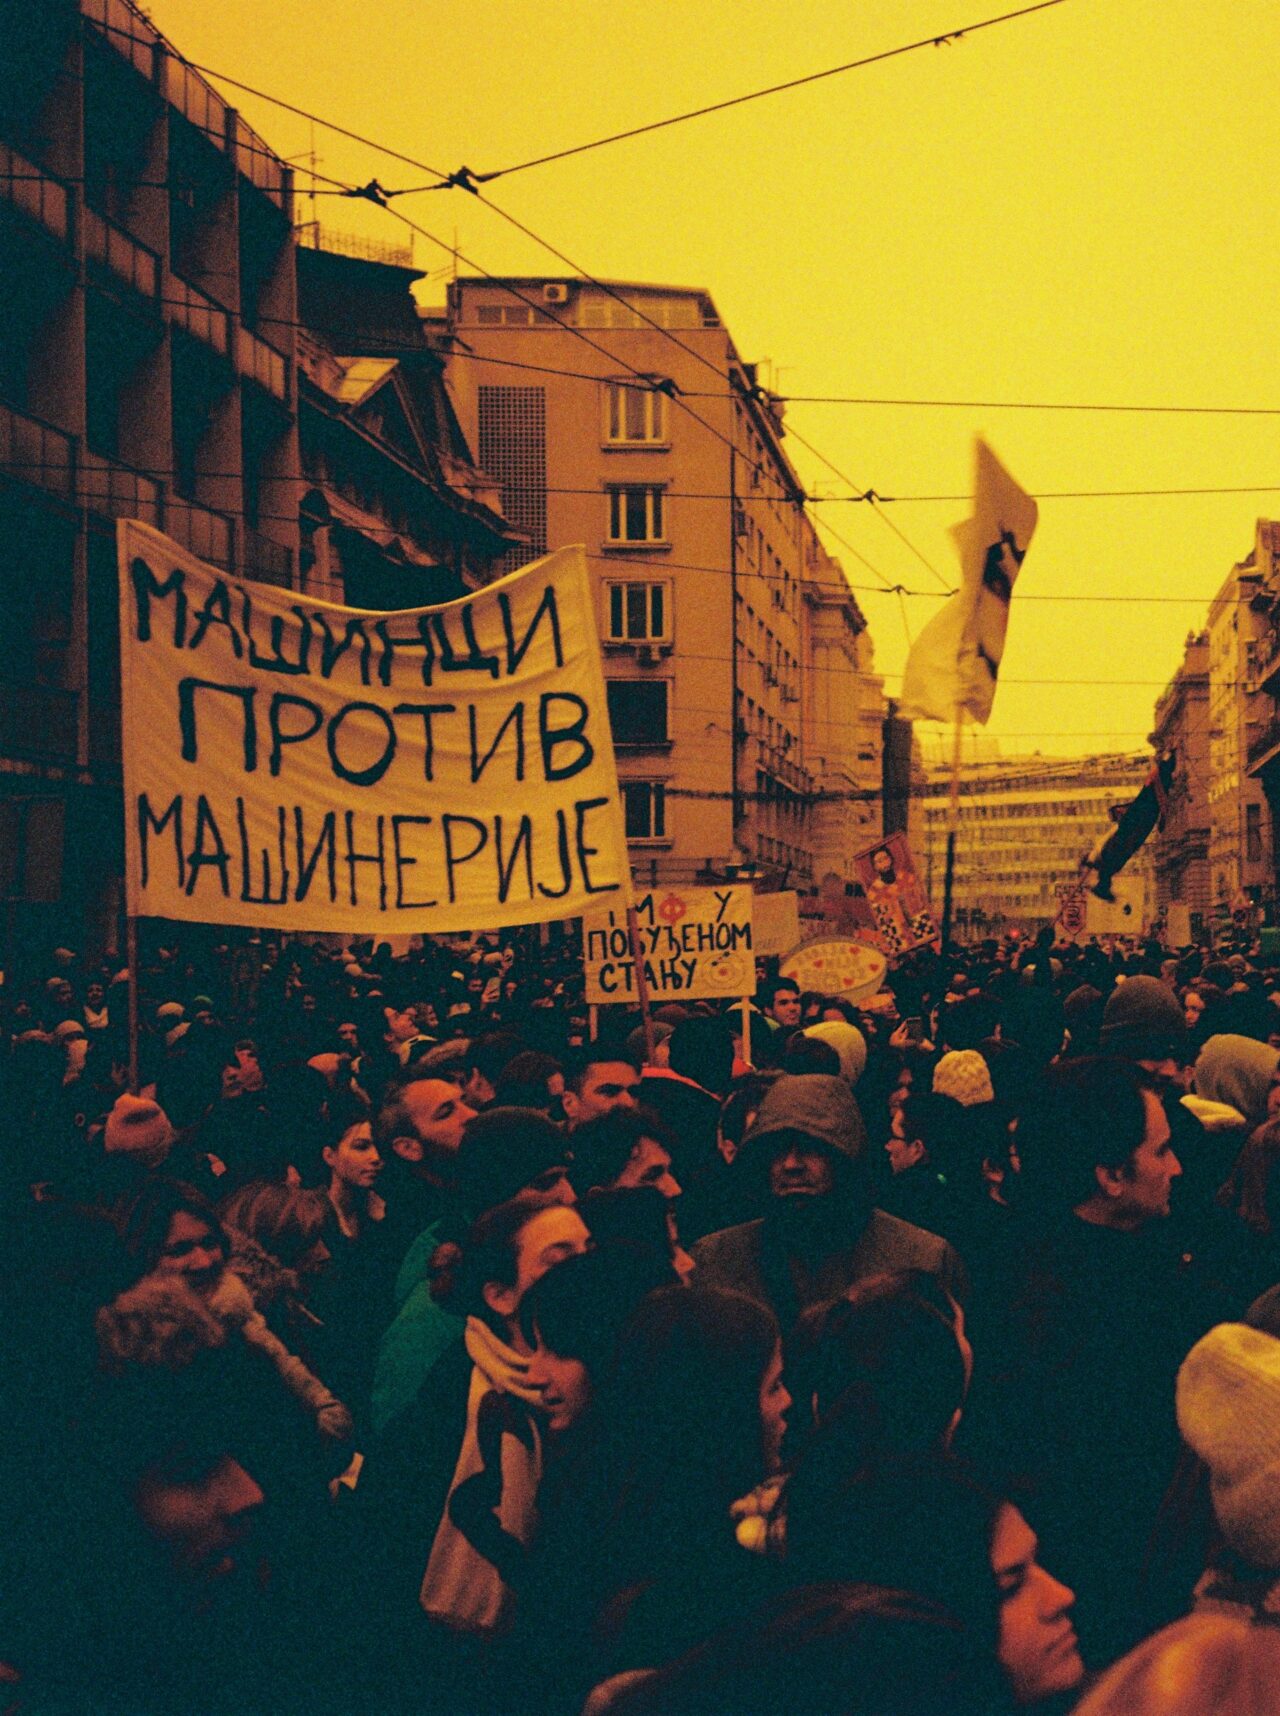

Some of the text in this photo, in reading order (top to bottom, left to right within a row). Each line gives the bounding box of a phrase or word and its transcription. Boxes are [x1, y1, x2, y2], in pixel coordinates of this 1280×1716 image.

[131, 557, 565, 687] МАШИНЦИ
[178, 677, 596, 787] ПРОТИВ
[137, 793, 620, 912] МАШИНЕРИЈЕ
[588, 922, 752, 962] ПОБУЂЕНОМ
[713, 891, 733, 923] У
[599, 958, 698, 993] СТАЊУ
